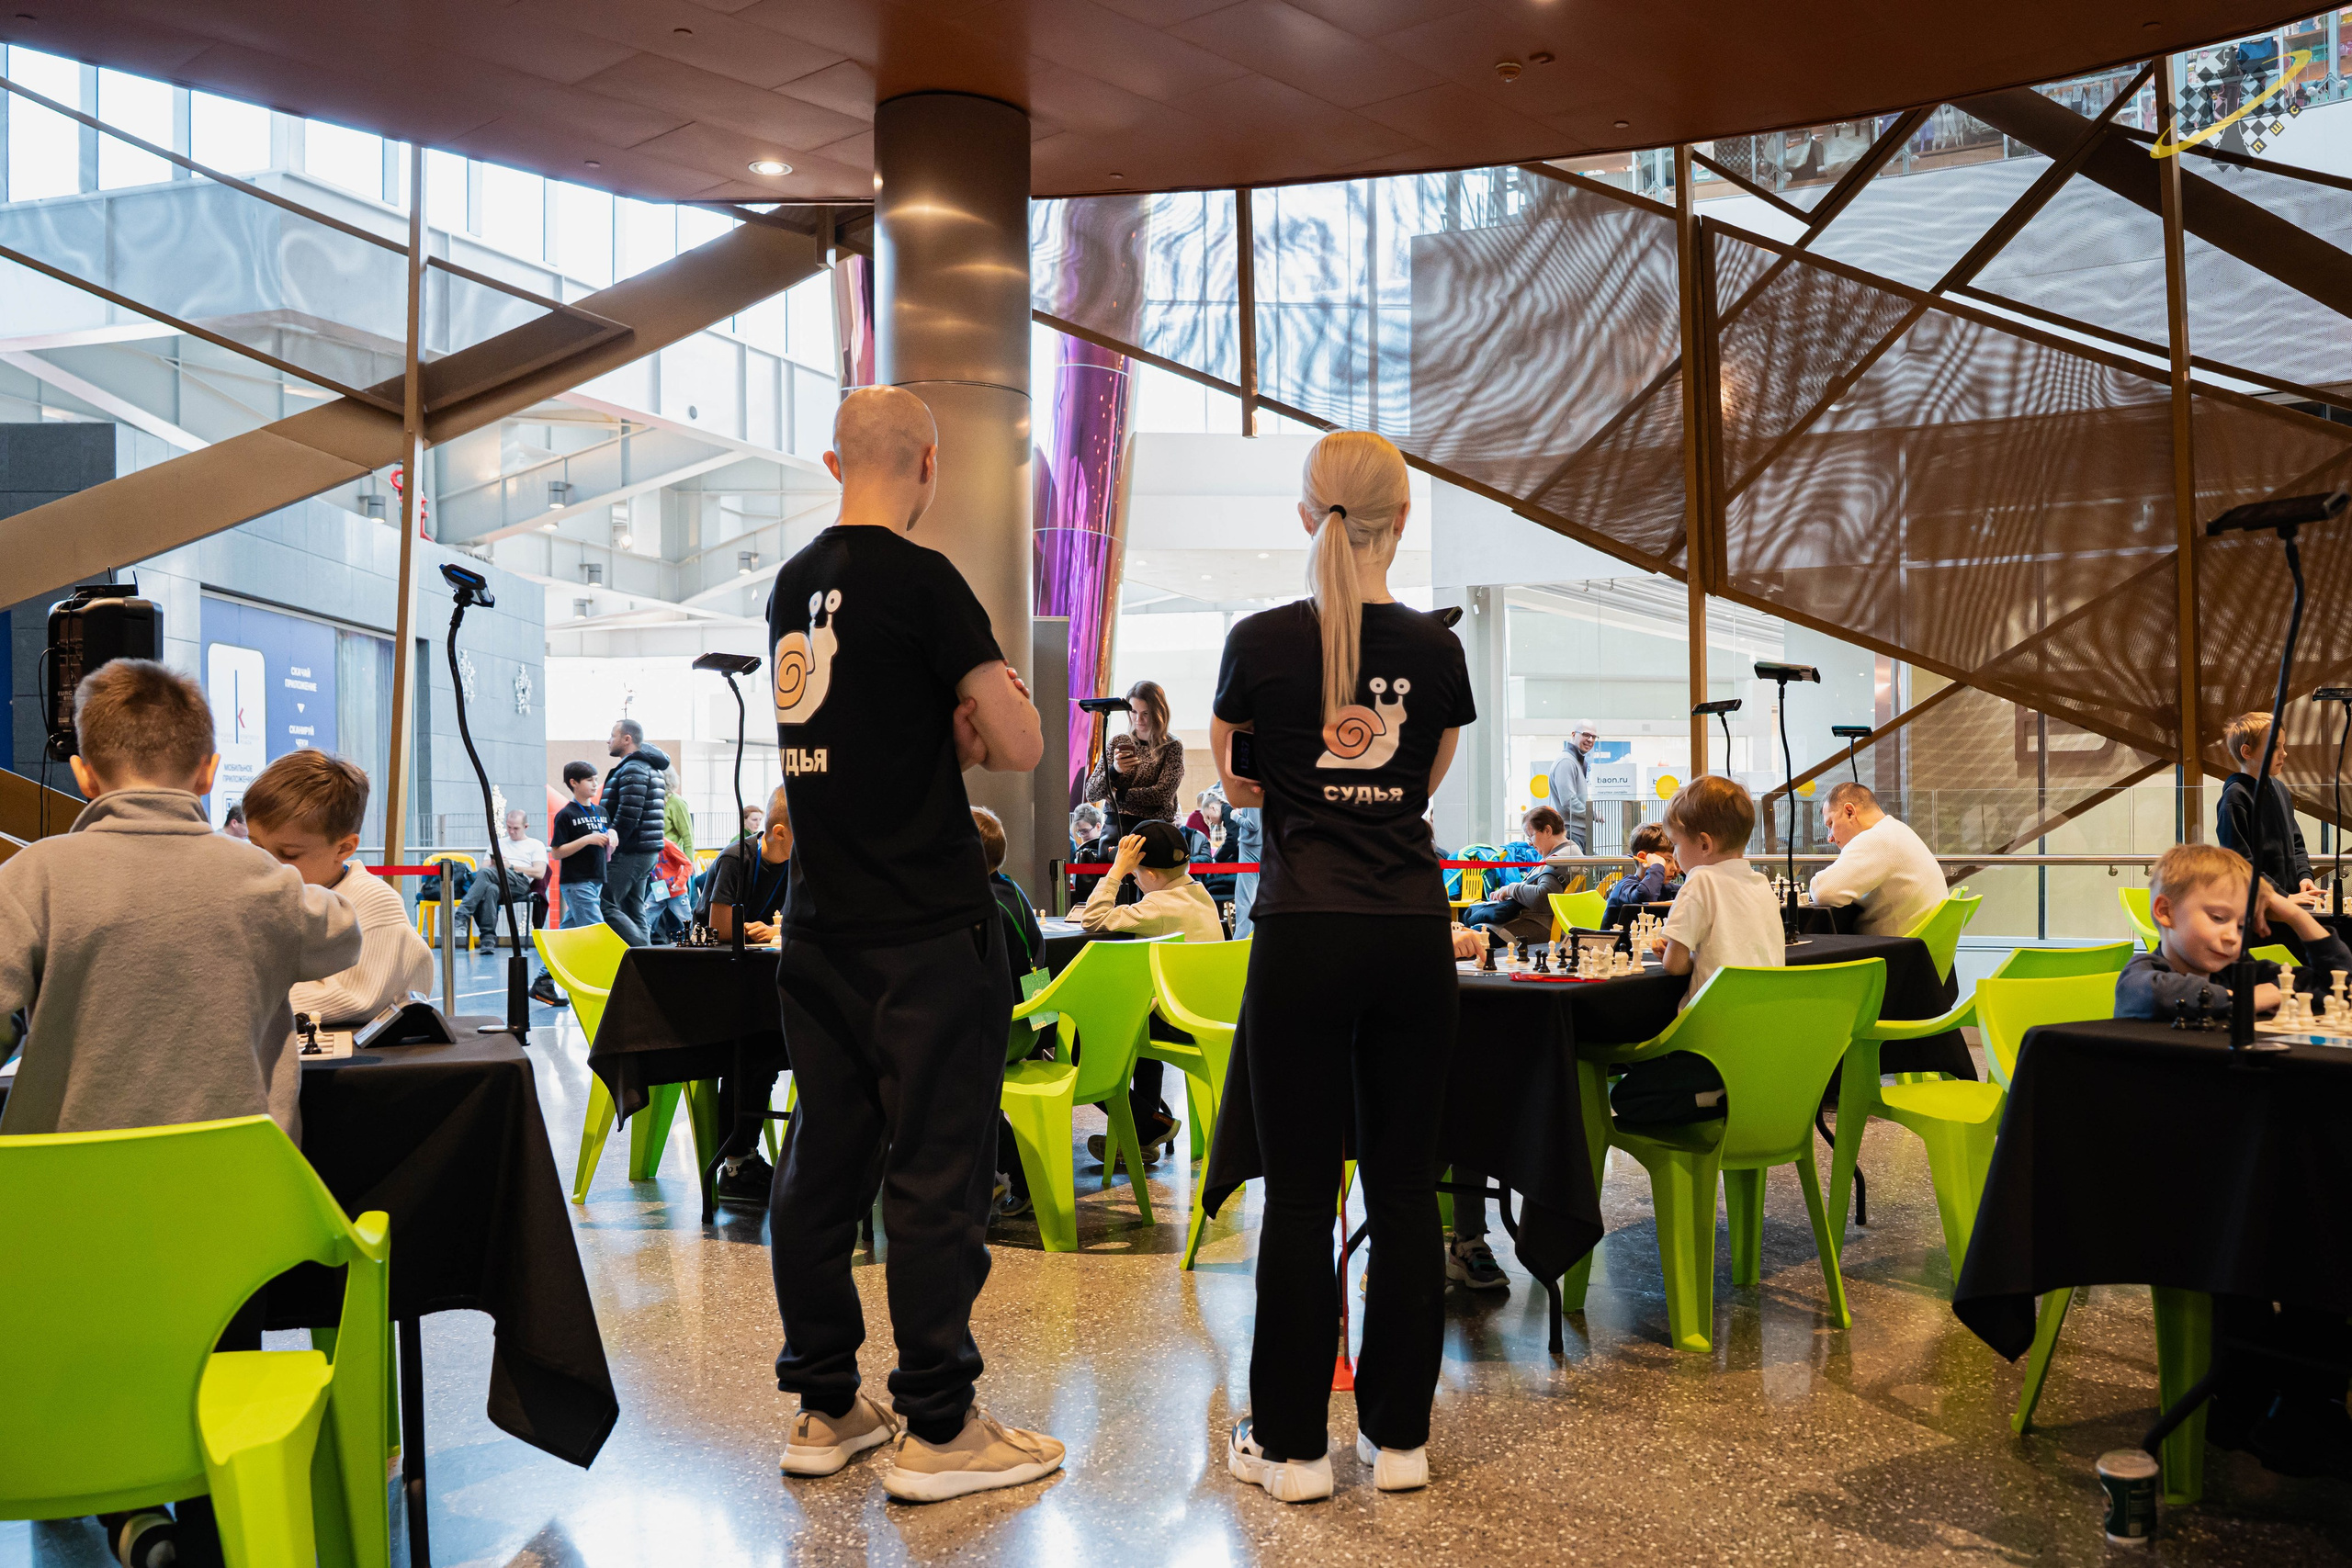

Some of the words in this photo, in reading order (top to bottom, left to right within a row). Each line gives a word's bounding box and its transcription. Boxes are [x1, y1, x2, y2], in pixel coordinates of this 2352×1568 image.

[290, 666, 311, 678] СКАЧАЙ
[284, 678, 318, 693] ПРИЛОЖЕНИЕ
[223, 763, 253, 773] МОБИЛЬНОЕ
[778, 748, 828, 777] УДЬЯ
[1323, 784, 1405, 805] СУДЬЯ
